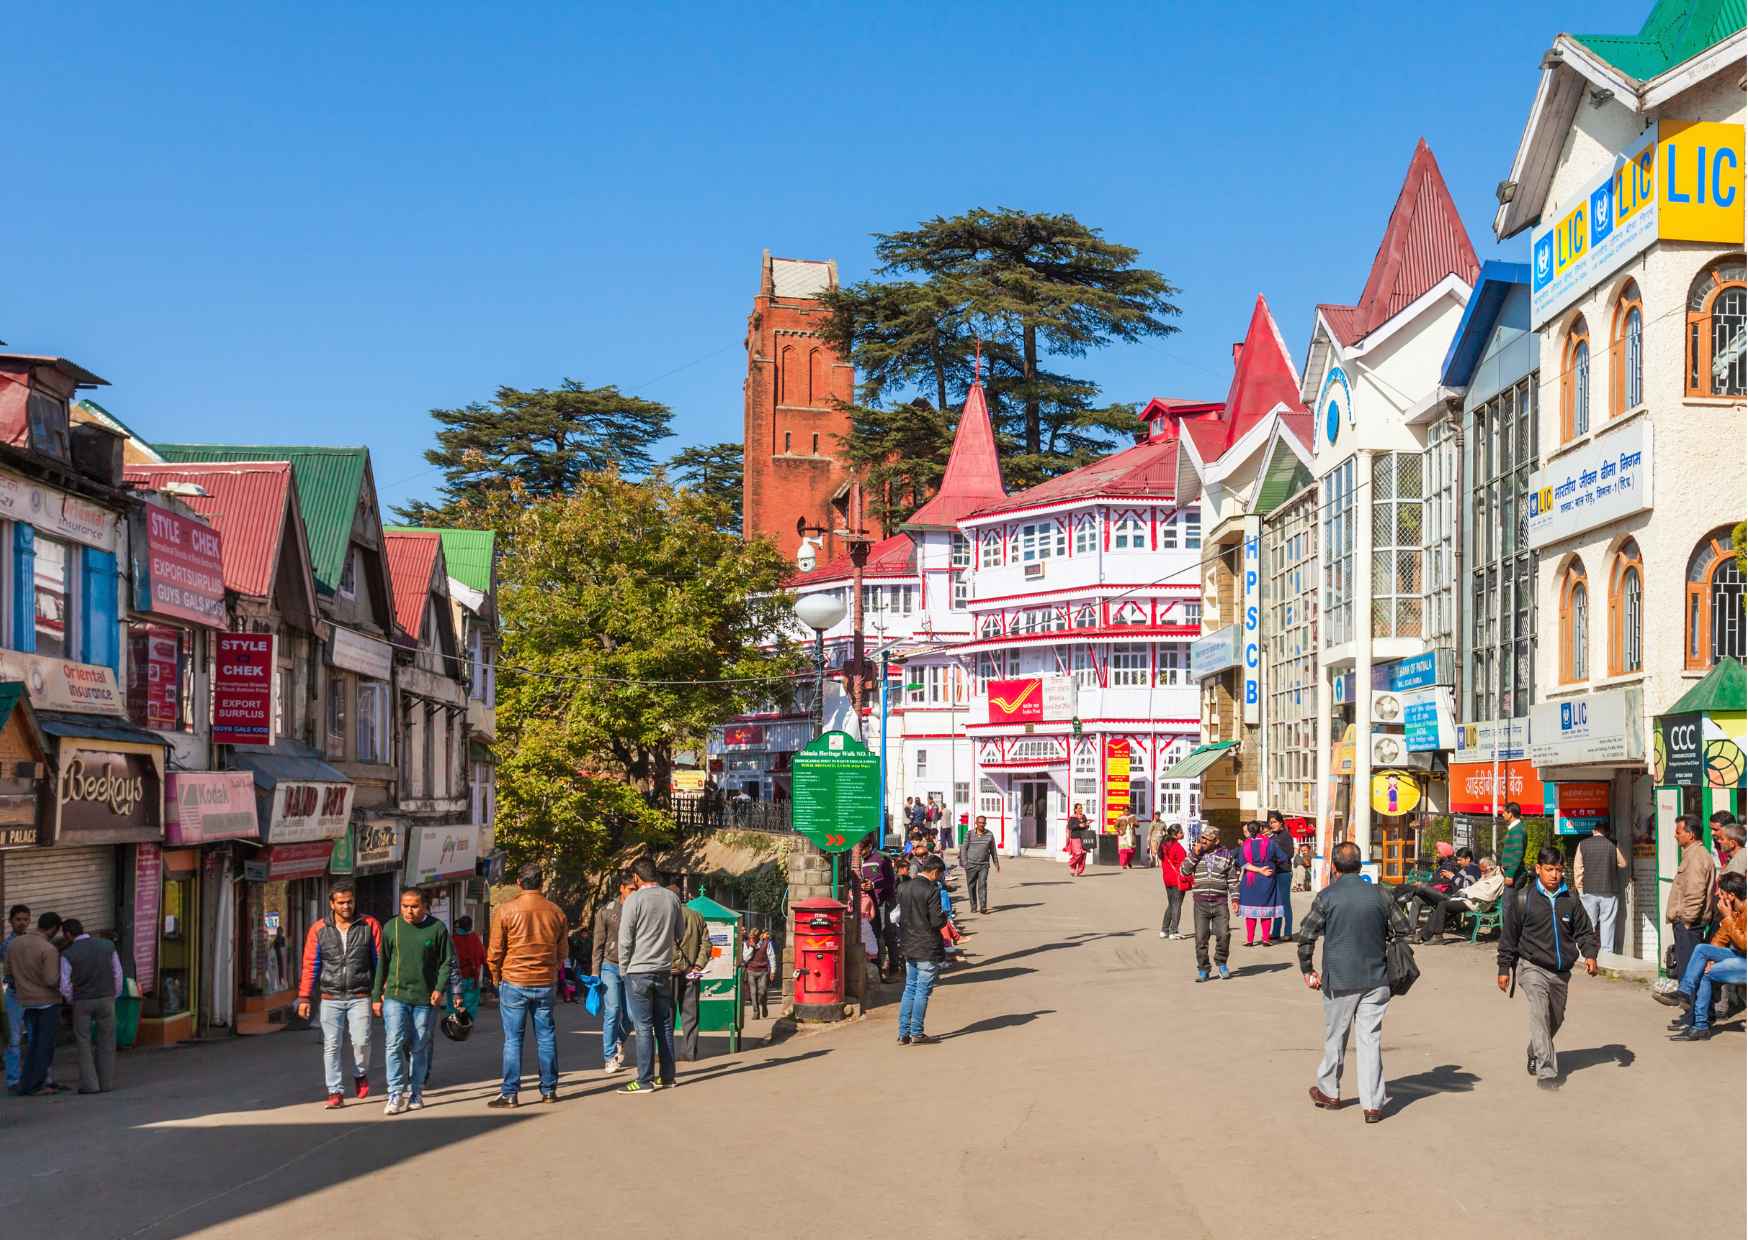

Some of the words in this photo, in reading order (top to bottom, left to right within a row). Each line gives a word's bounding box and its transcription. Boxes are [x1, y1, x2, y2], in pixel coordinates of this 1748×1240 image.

[1618, 151, 1651, 219] LIC
[1667, 143, 1737, 208] LIC
[1557, 209, 1584, 267] LIC
[1579, 469, 1597, 489] जीवन
[1600, 459, 1617, 480] बीमा
[1620, 450, 1642, 473] निगम
[1540, 488, 1552, 513] LIC
[152, 511, 180, 545] STYLE
[192, 528, 219, 560] CHEK
[158, 583, 180, 604] GUYS
[184, 592, 204, 612] GALS
[221, 639, 267, 652] STYLE
[223, 665, 264, 676] CHEK
[219, 709, 265, 719] SURPLUS
[222, 699, 262, 709] EXPORT
[1573, 701, 1587, 726] LIC
[1466, 727, 1477, 748] LIC
[1670, 724, 1697, 751] CCC
[62, 758, 144, 816] Beekays
[1508, 767, 1524, 797] बैंक
[10, 829, 37, 844] PALACE
